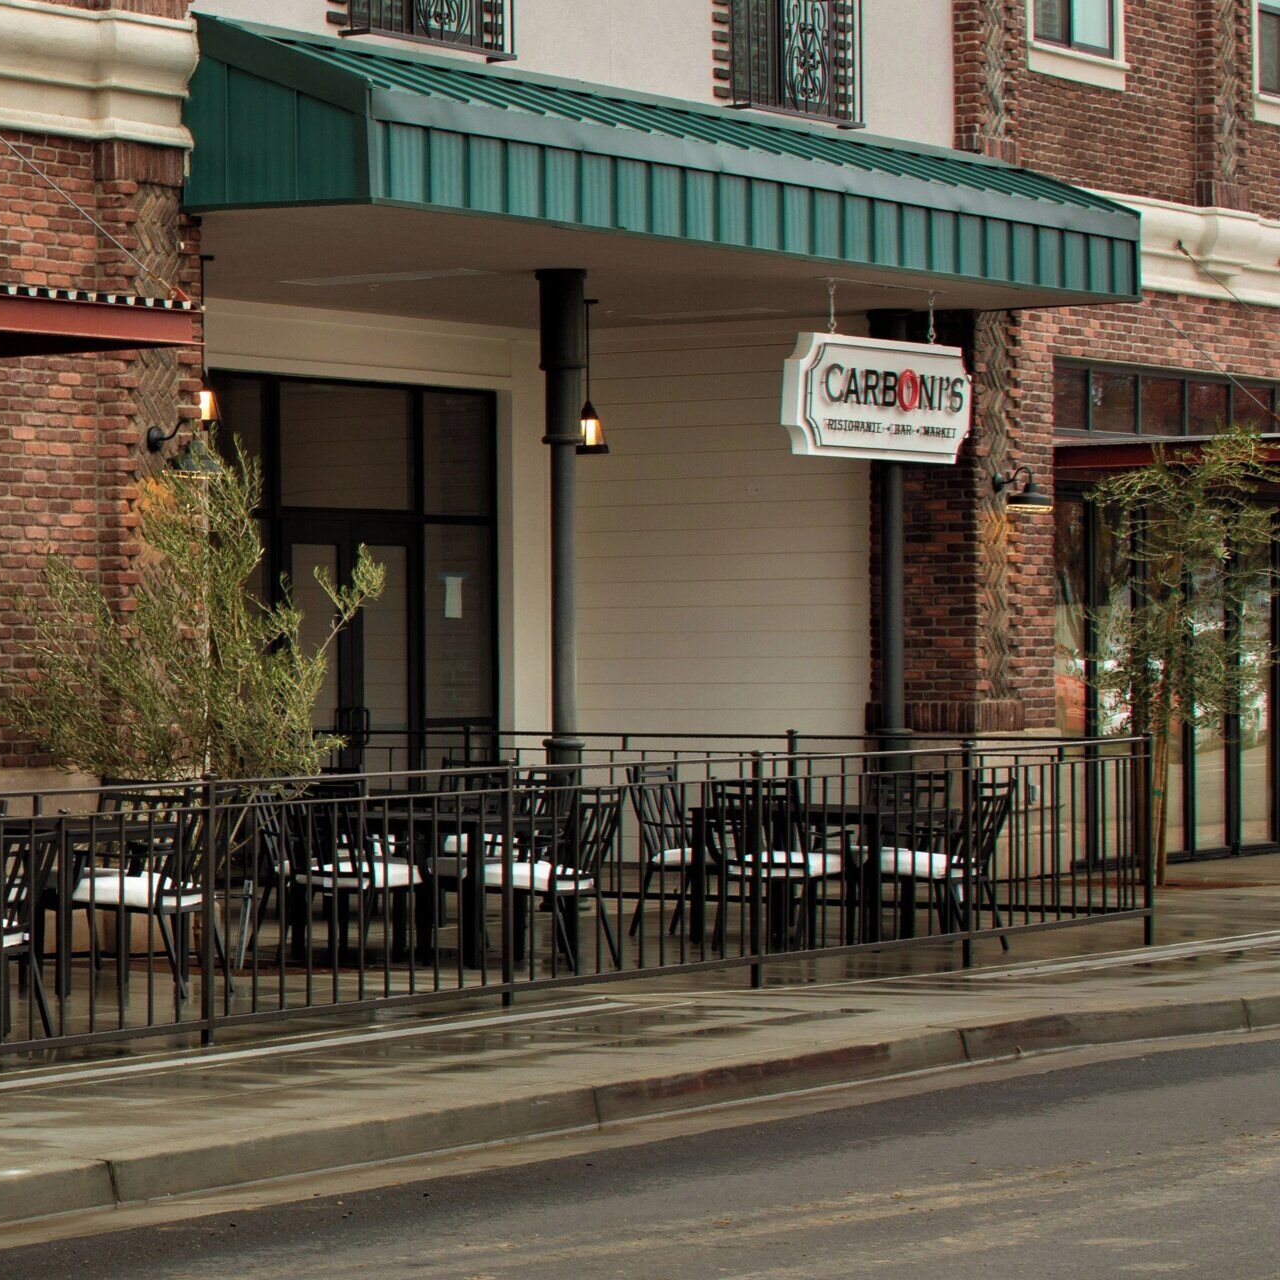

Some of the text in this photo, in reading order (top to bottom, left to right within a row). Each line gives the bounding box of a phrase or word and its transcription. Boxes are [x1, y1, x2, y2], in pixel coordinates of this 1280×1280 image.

[824, 363, 965, 413] CARBONI'S
[827, 418, 958, 439] RISTORANTE BAR MARKET
